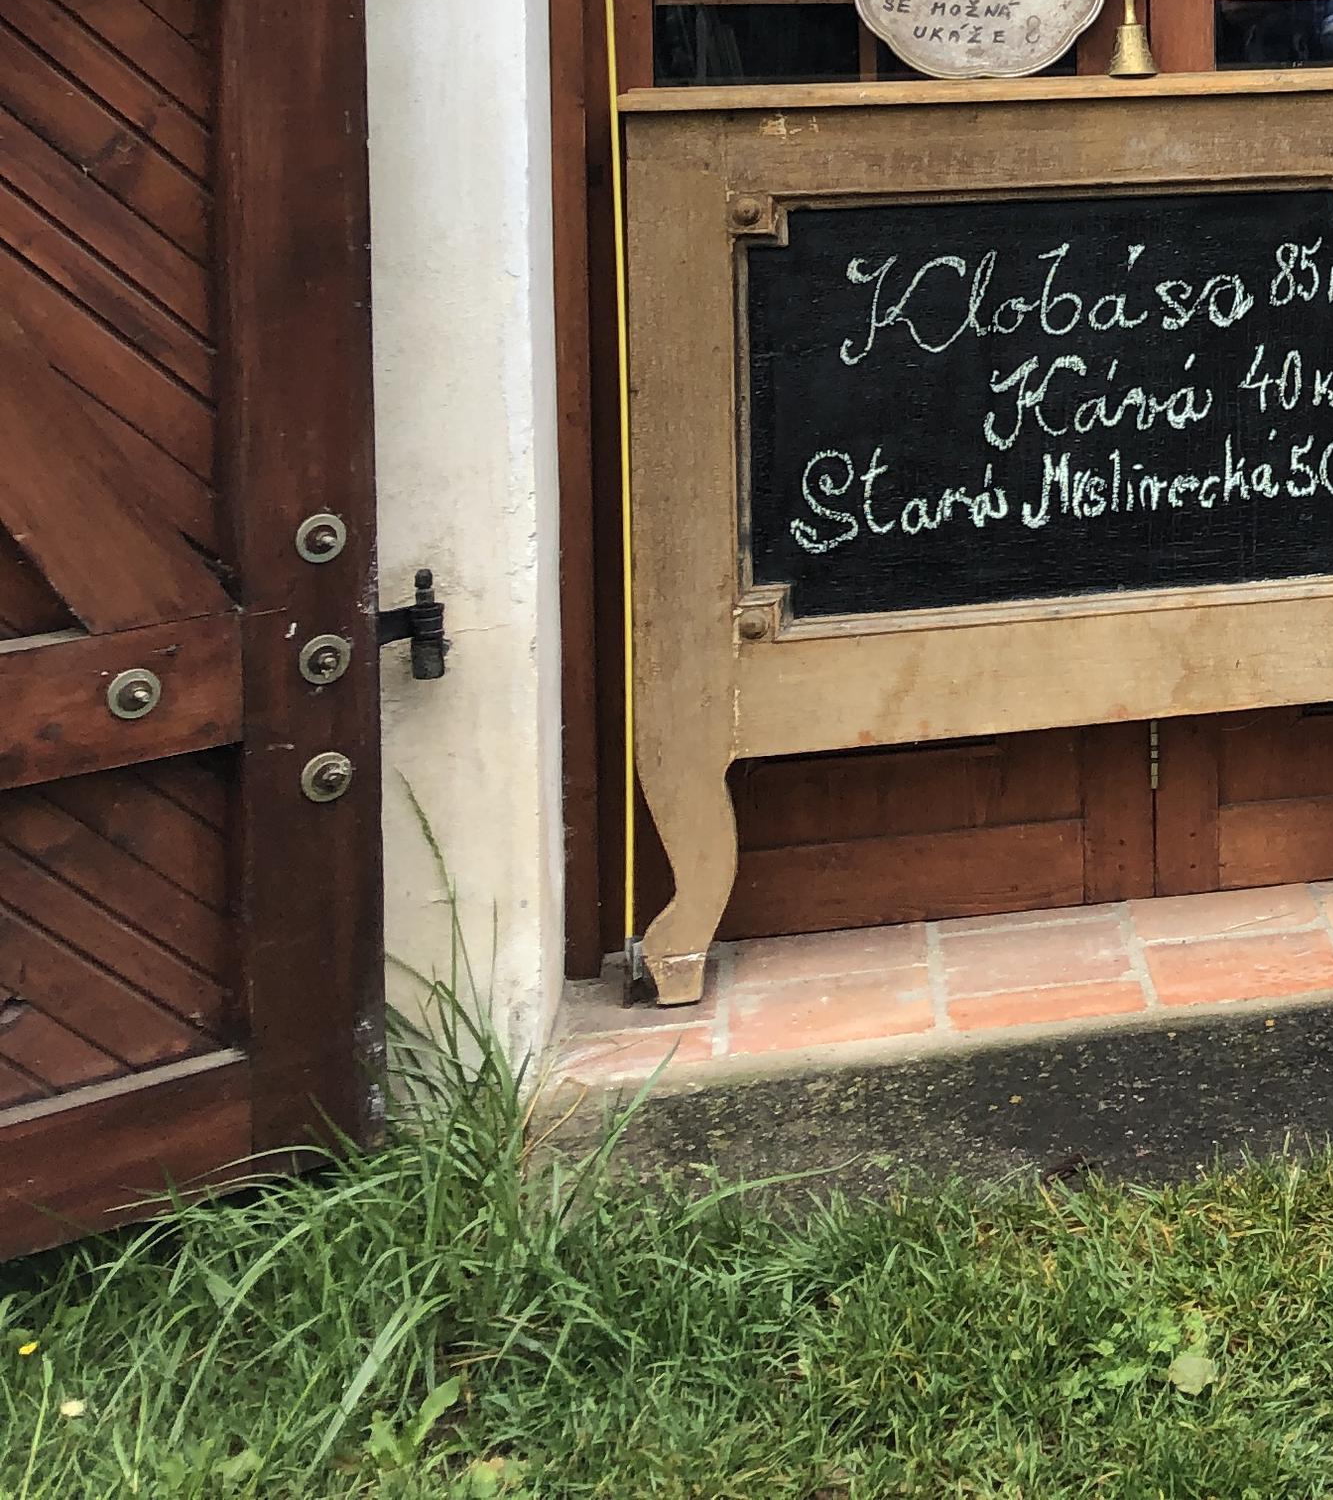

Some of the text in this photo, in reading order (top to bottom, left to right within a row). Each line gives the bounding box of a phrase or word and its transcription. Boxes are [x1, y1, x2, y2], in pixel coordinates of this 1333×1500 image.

[931, 0, 1020, 20] MOŽNÁ
[913, 23, 1005, 44] UKÁŽE
[1269, 237, 1322, 306] 85
[1238, 343, 1302, 413] 40
